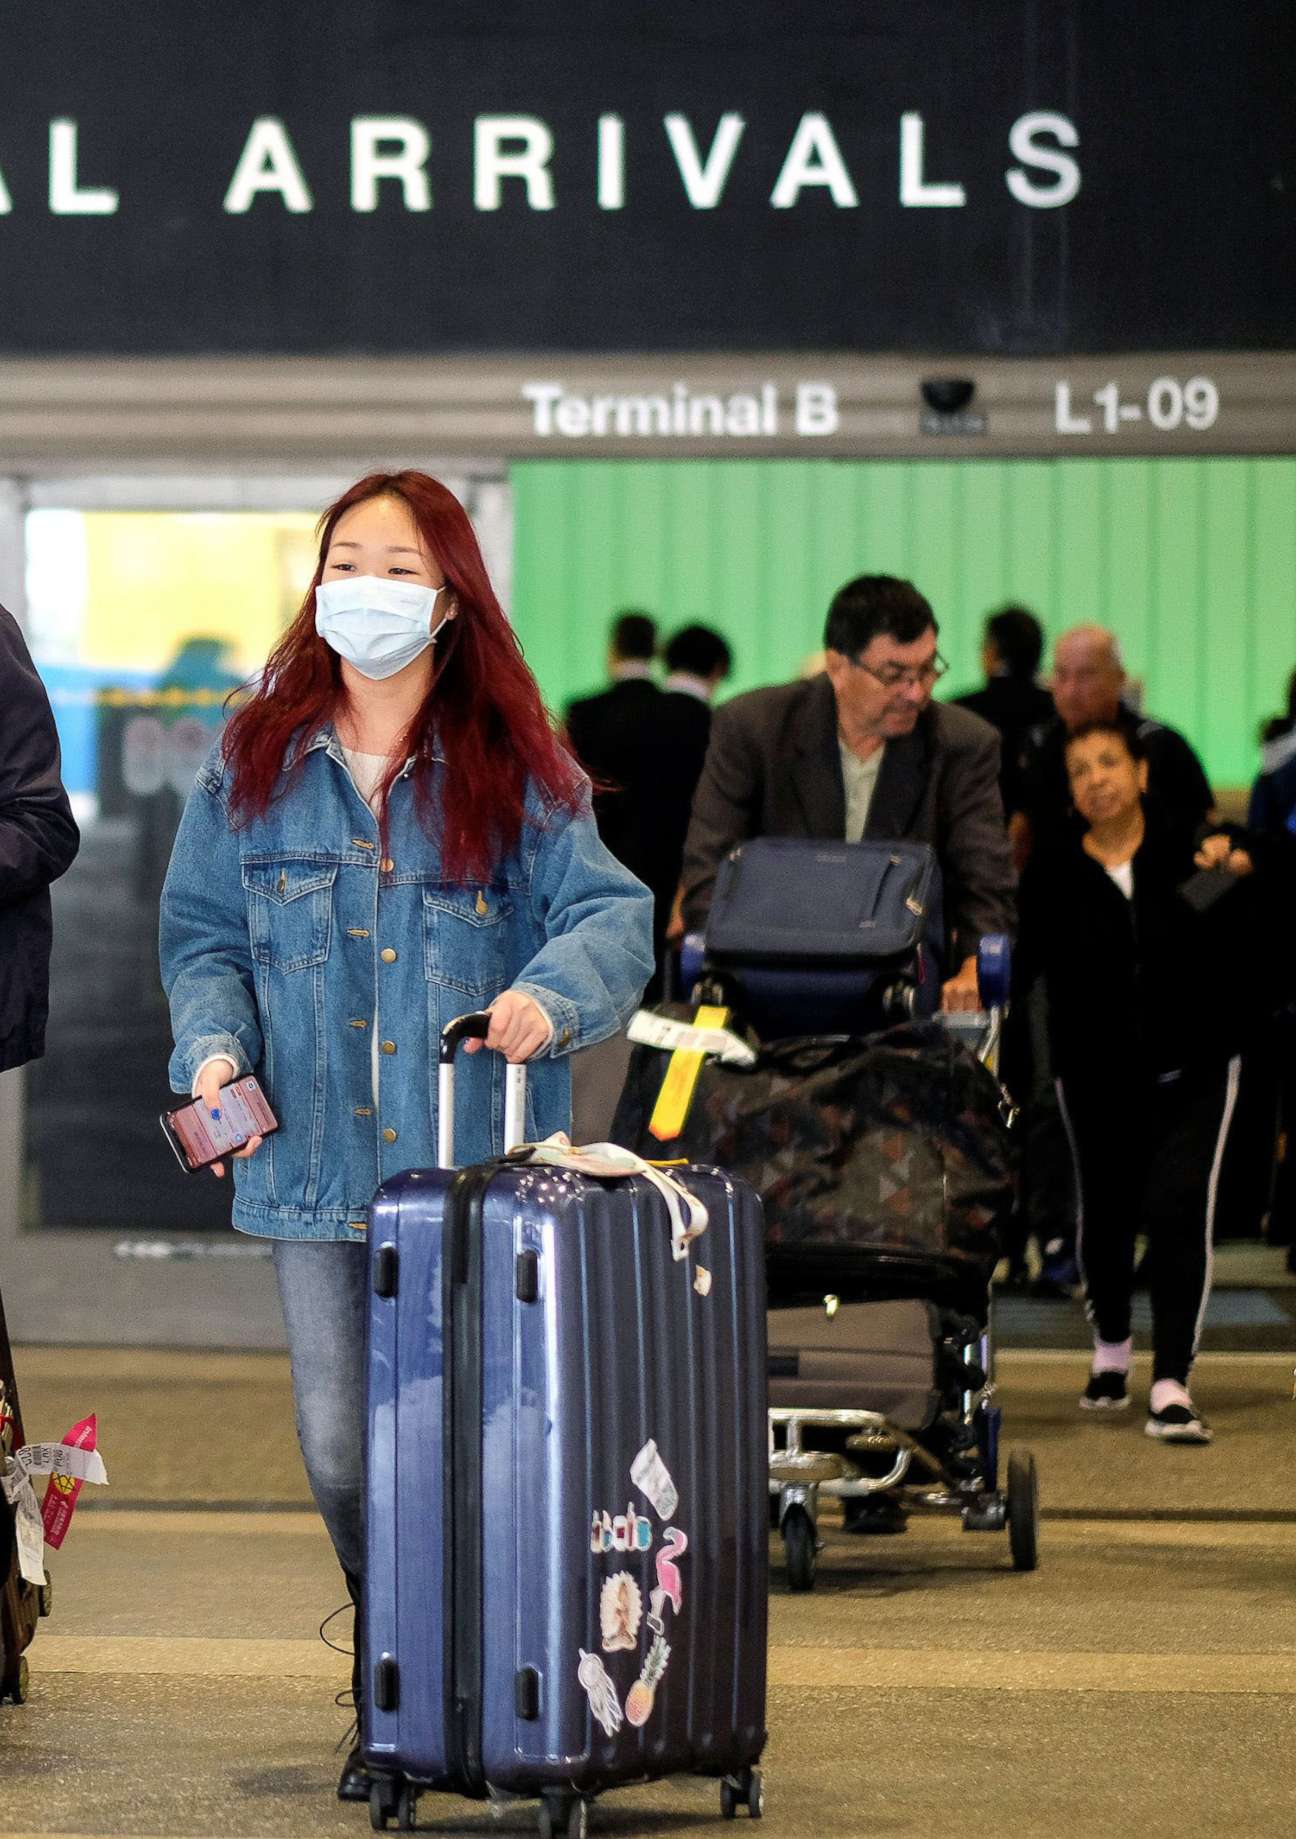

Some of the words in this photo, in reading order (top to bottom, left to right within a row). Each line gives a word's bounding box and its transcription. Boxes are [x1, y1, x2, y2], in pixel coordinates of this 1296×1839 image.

[223, 112, 1082, 214] ARRIVALS
[521, 382, 778, 437] Terminal
[795, 383, 840, 437] B
[1054, 380, 1219, 434] L1-09
